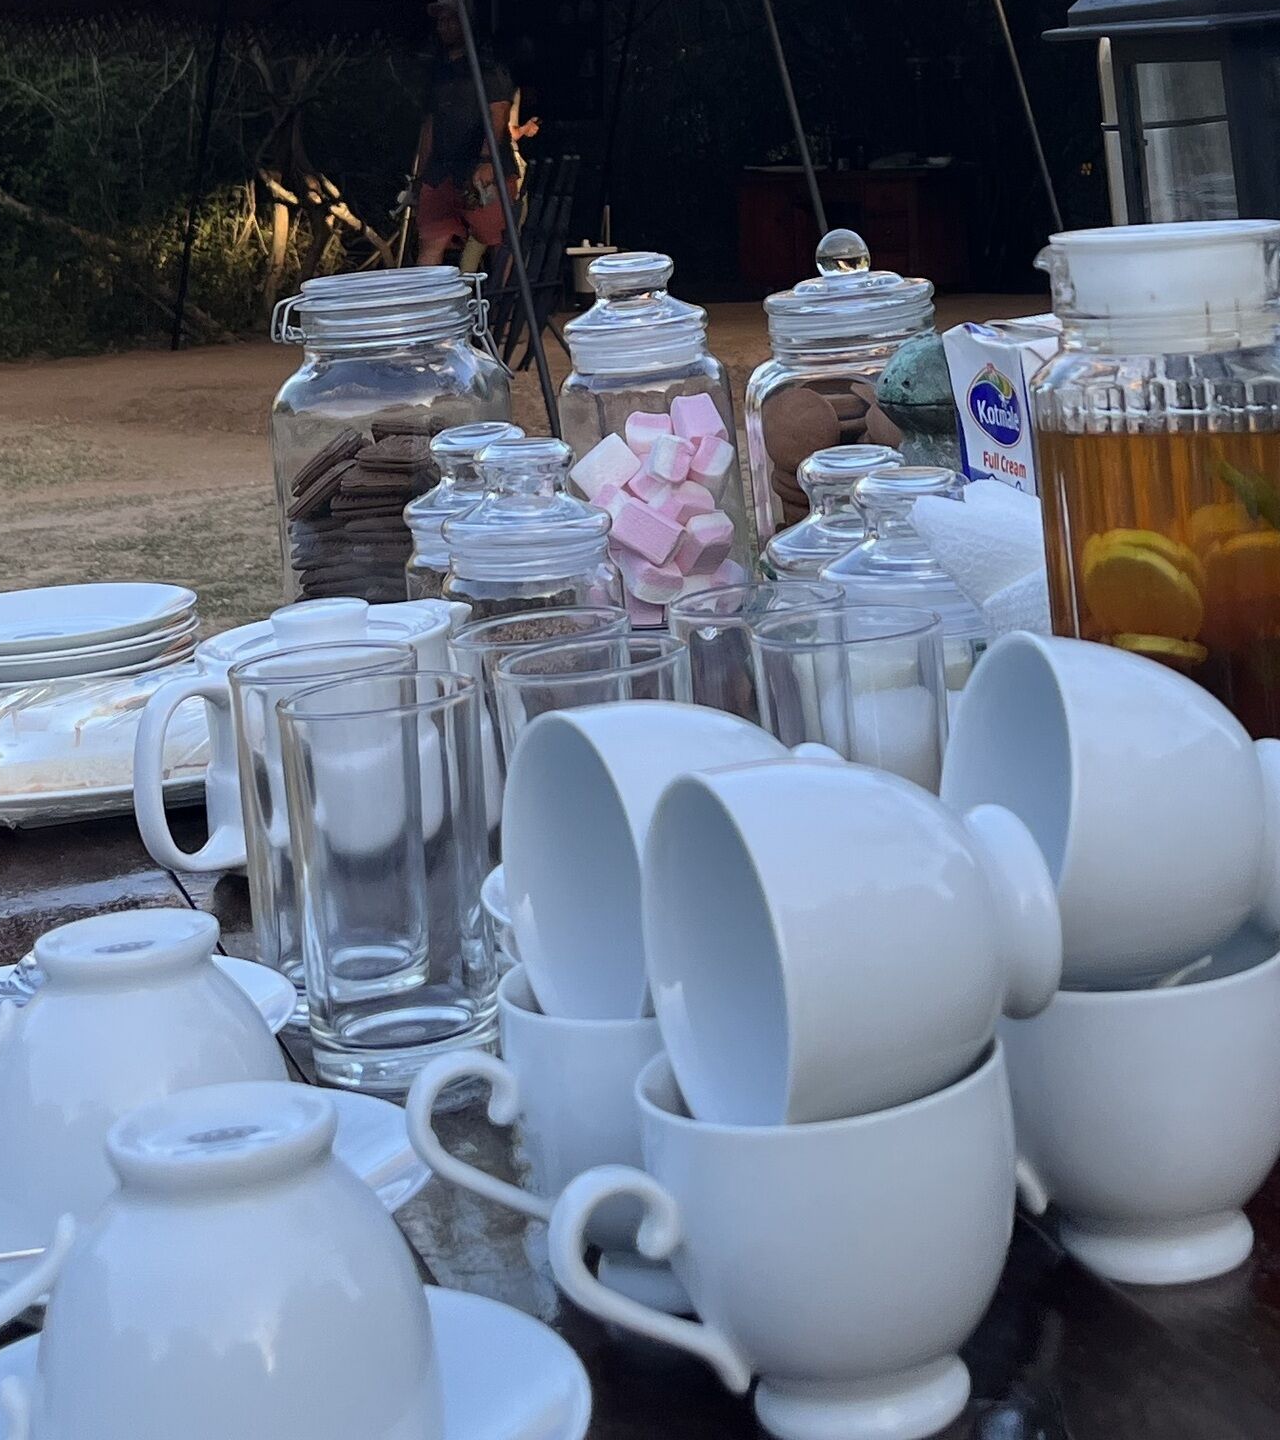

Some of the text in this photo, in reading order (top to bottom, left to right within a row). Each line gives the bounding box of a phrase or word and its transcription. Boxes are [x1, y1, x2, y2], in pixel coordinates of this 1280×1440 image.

[976, 399, 1020, 432] Kotmale
[983, 451, 1027, 479] Full Cream
